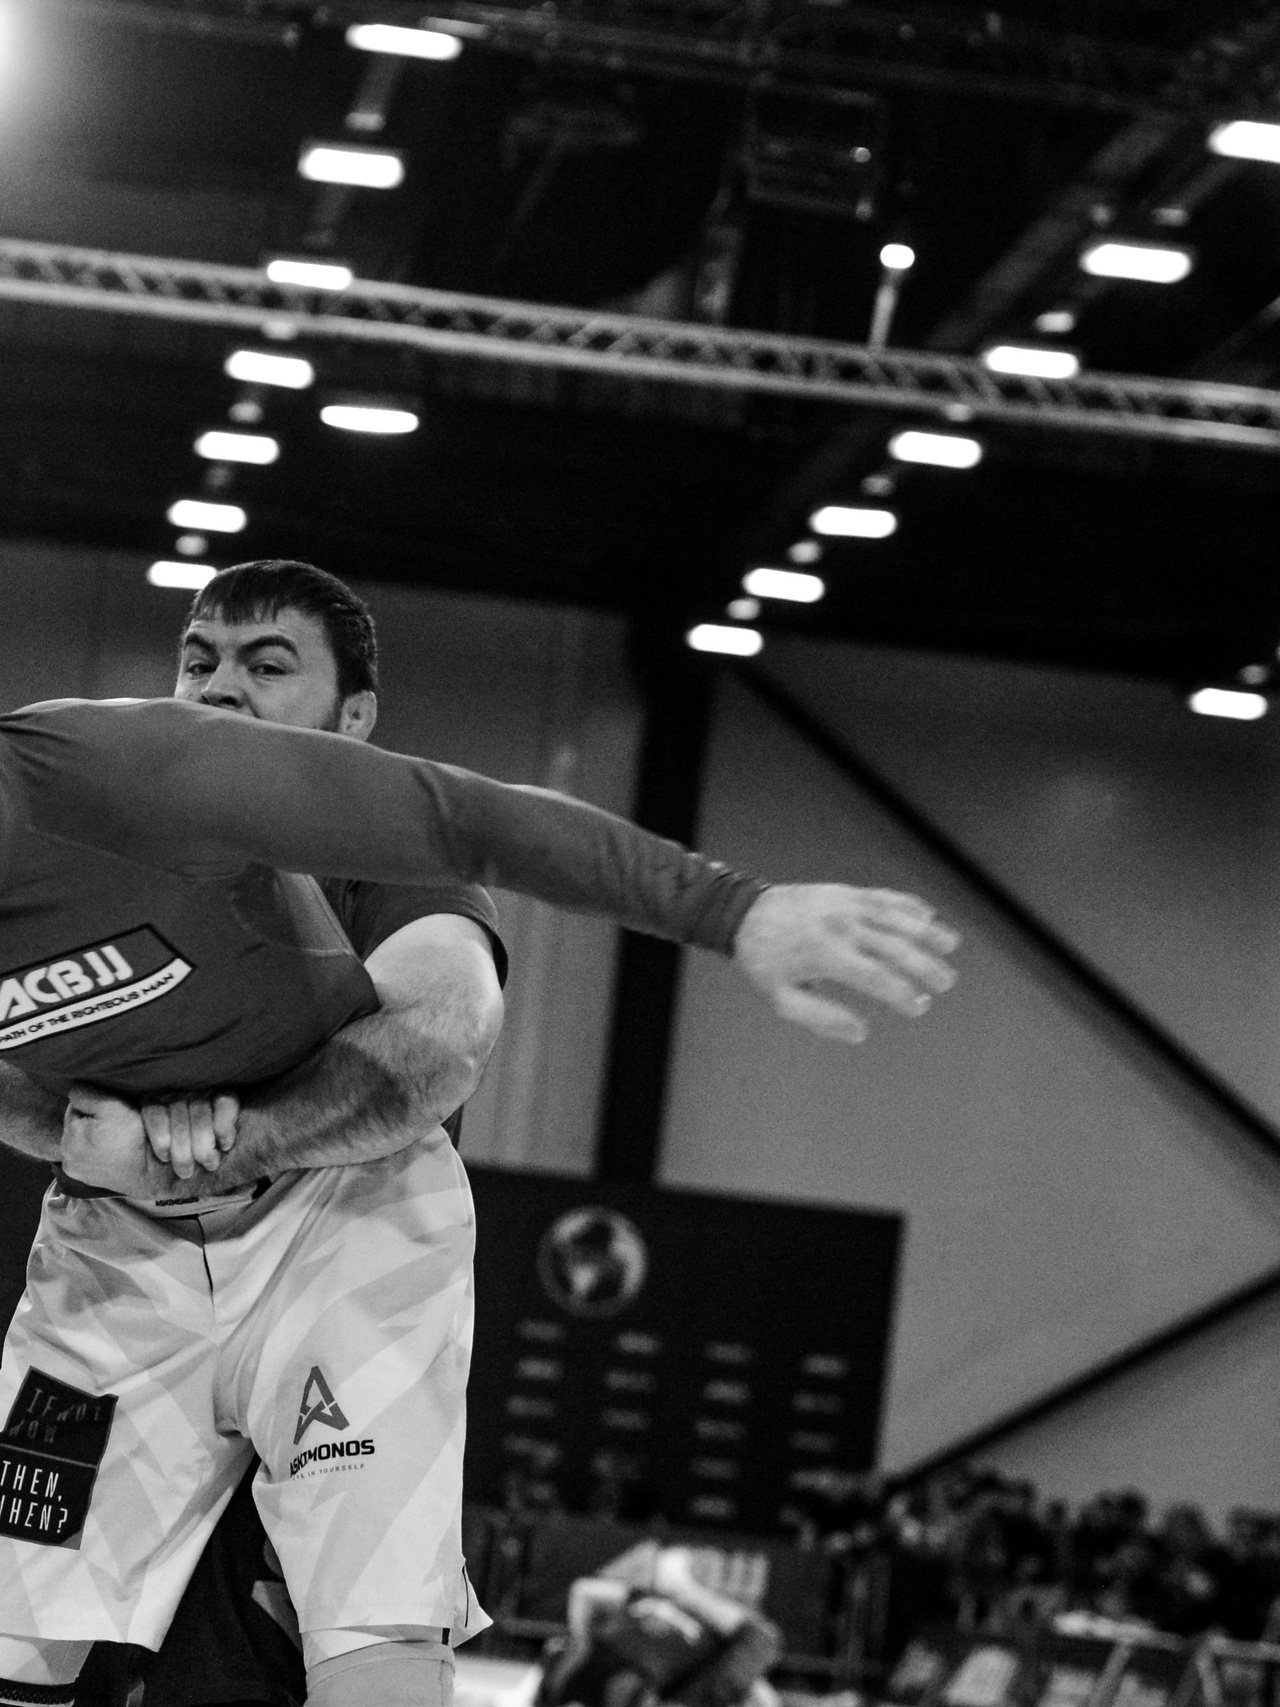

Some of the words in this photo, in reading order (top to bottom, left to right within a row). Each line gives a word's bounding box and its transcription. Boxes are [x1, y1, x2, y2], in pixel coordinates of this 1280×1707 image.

[28, 1019, 47, 1034] OF
[47, 1011, 70, 1027] THE
[71, 990, 139, 1020] RIGHTEOUS
[142, 972, 175, 996] MAN
[289, 1439, 376, 1478] ASKIMONOS
[0, 1460, 62, 1502] THEN,
